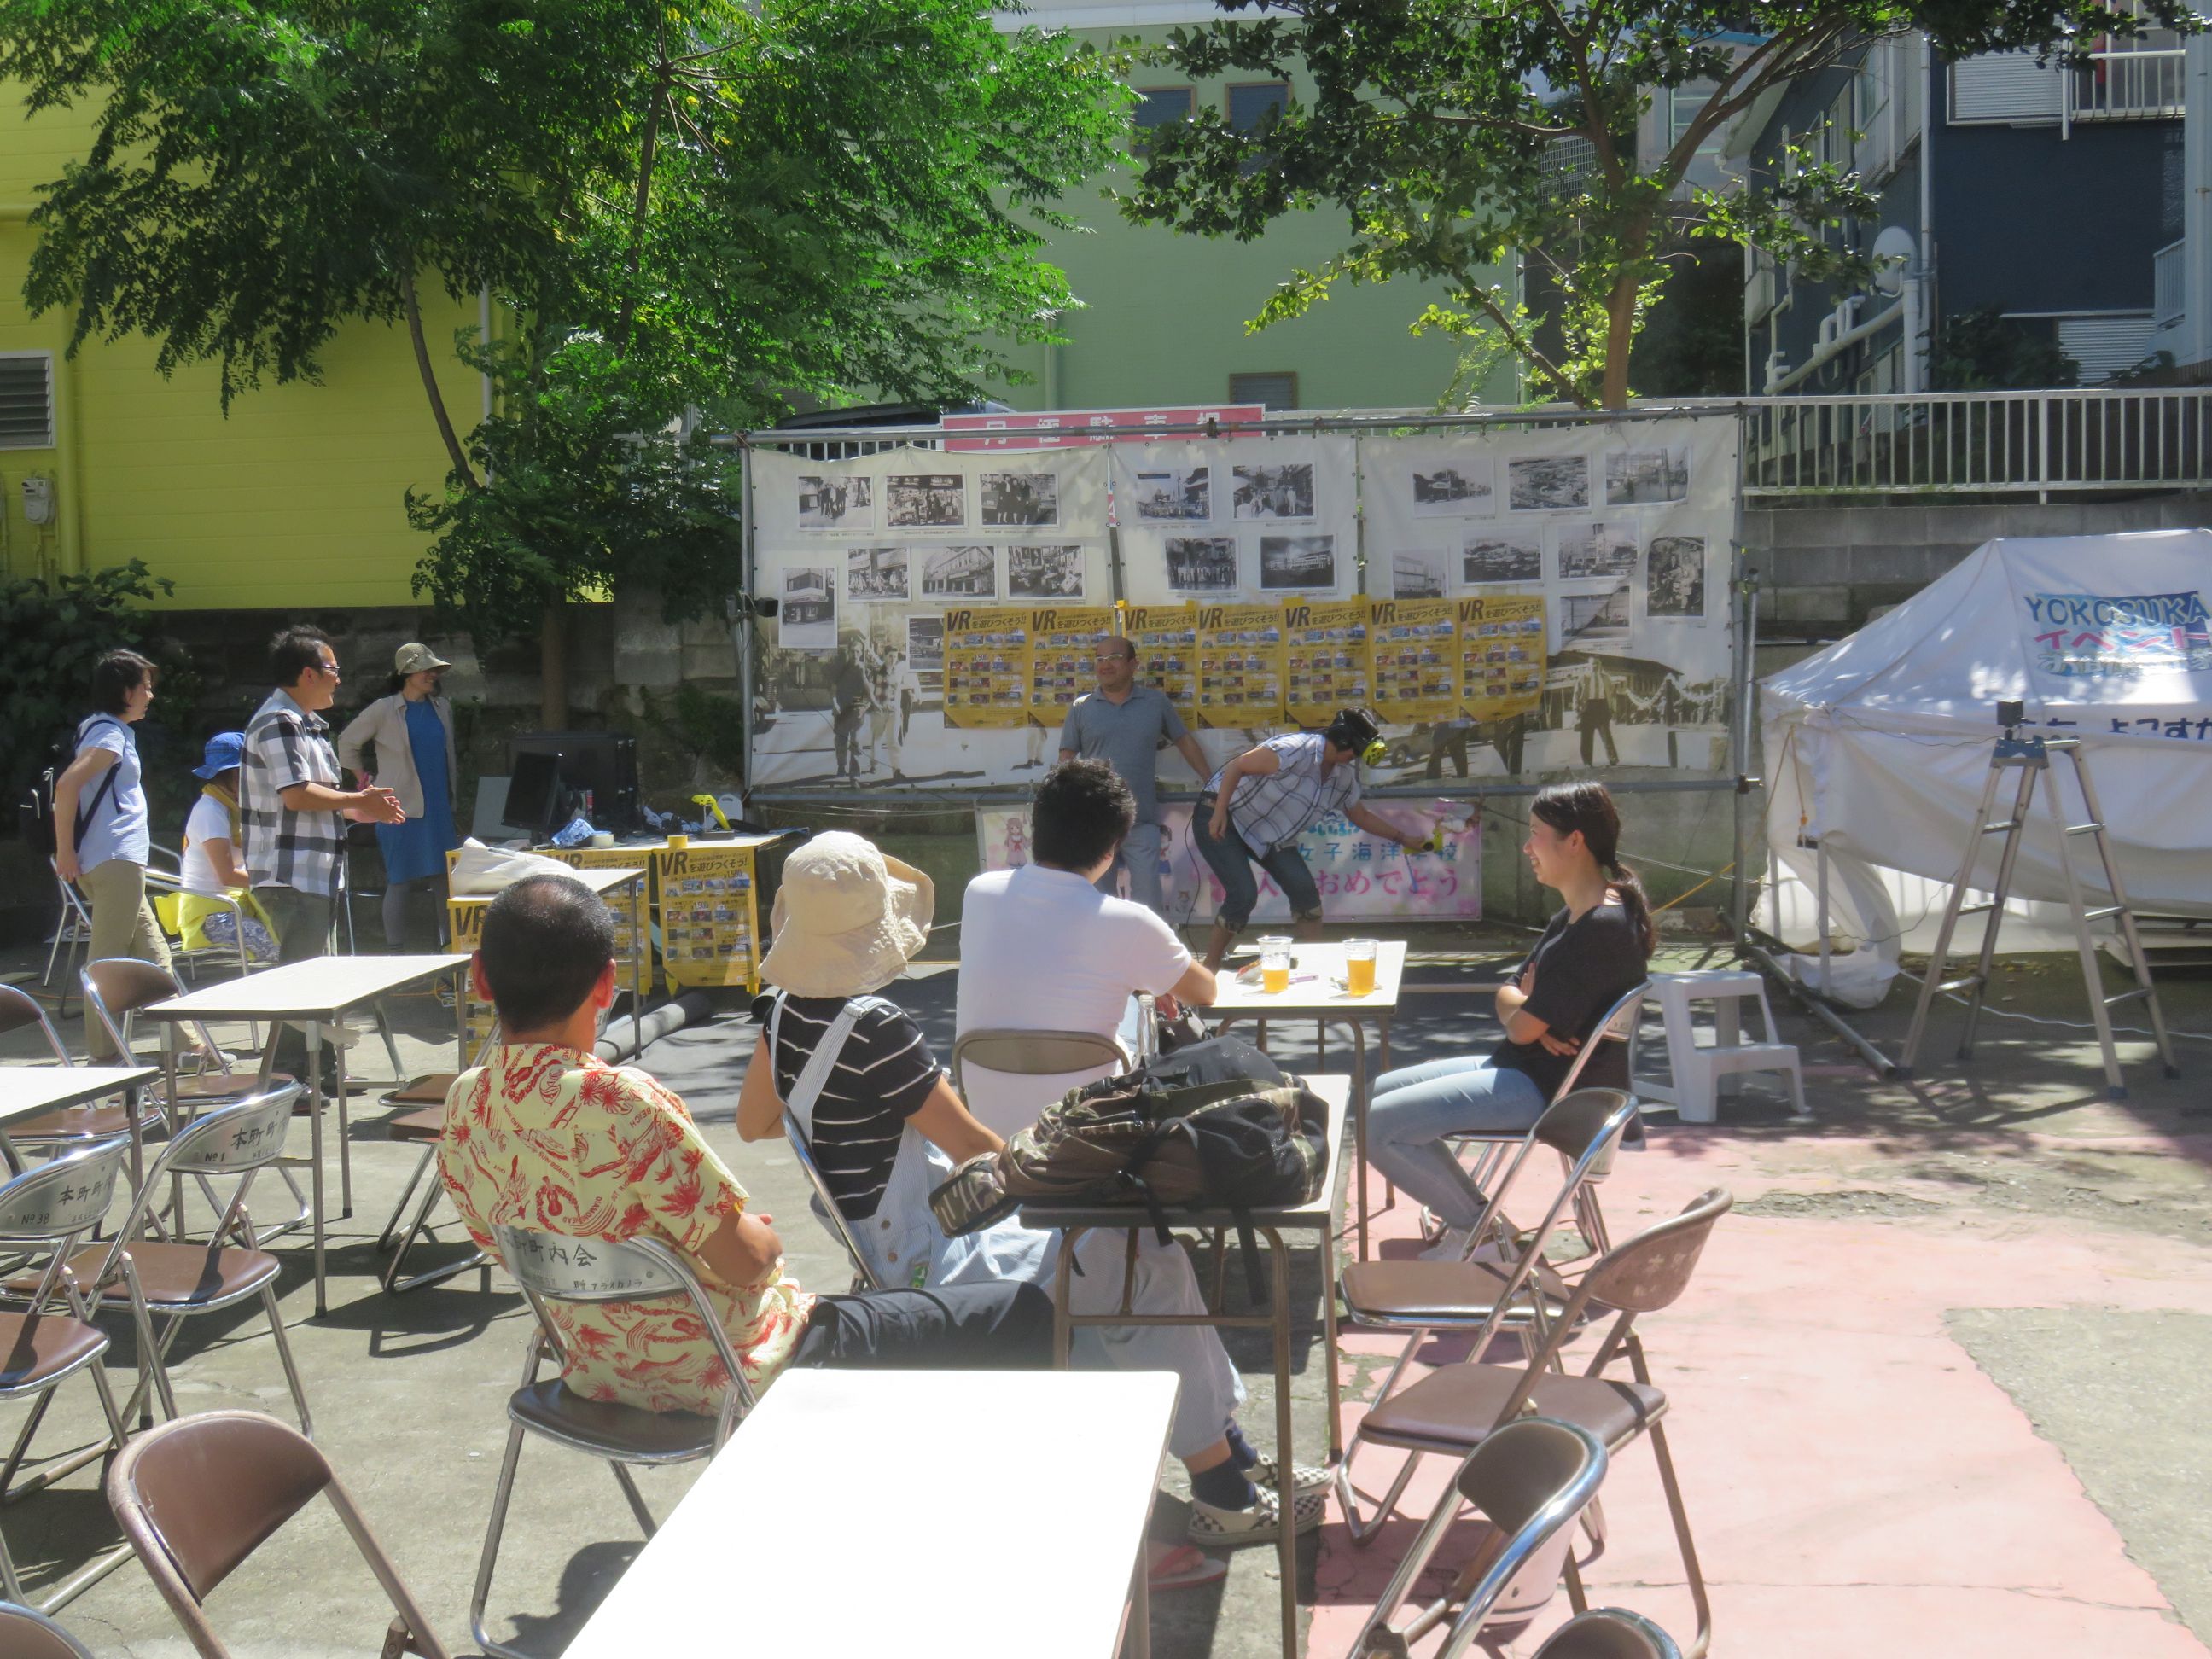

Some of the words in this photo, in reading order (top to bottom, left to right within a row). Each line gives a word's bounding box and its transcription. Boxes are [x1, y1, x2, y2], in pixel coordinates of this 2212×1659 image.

[947, 610, 971, 631] VR
[1033, 609, 1057, 631] VR
[1125, 608, 1147, 630] VR
[1199, 608, 1223, 629] VR
[1286, 607, 1310, 628] VR
[1371, 603, 1395, 625] VR
[1459, 600, 1484, 622] VR
[2023, 594, 2210, 627] YOKOSUKA
[2034, 626, 2210, 652] イベント
[1298, 841, 1458, 862] 女子海洋校
[661, 852, 688, 876] VR
[1257, 869, 1458, 896] 入おめでとう
